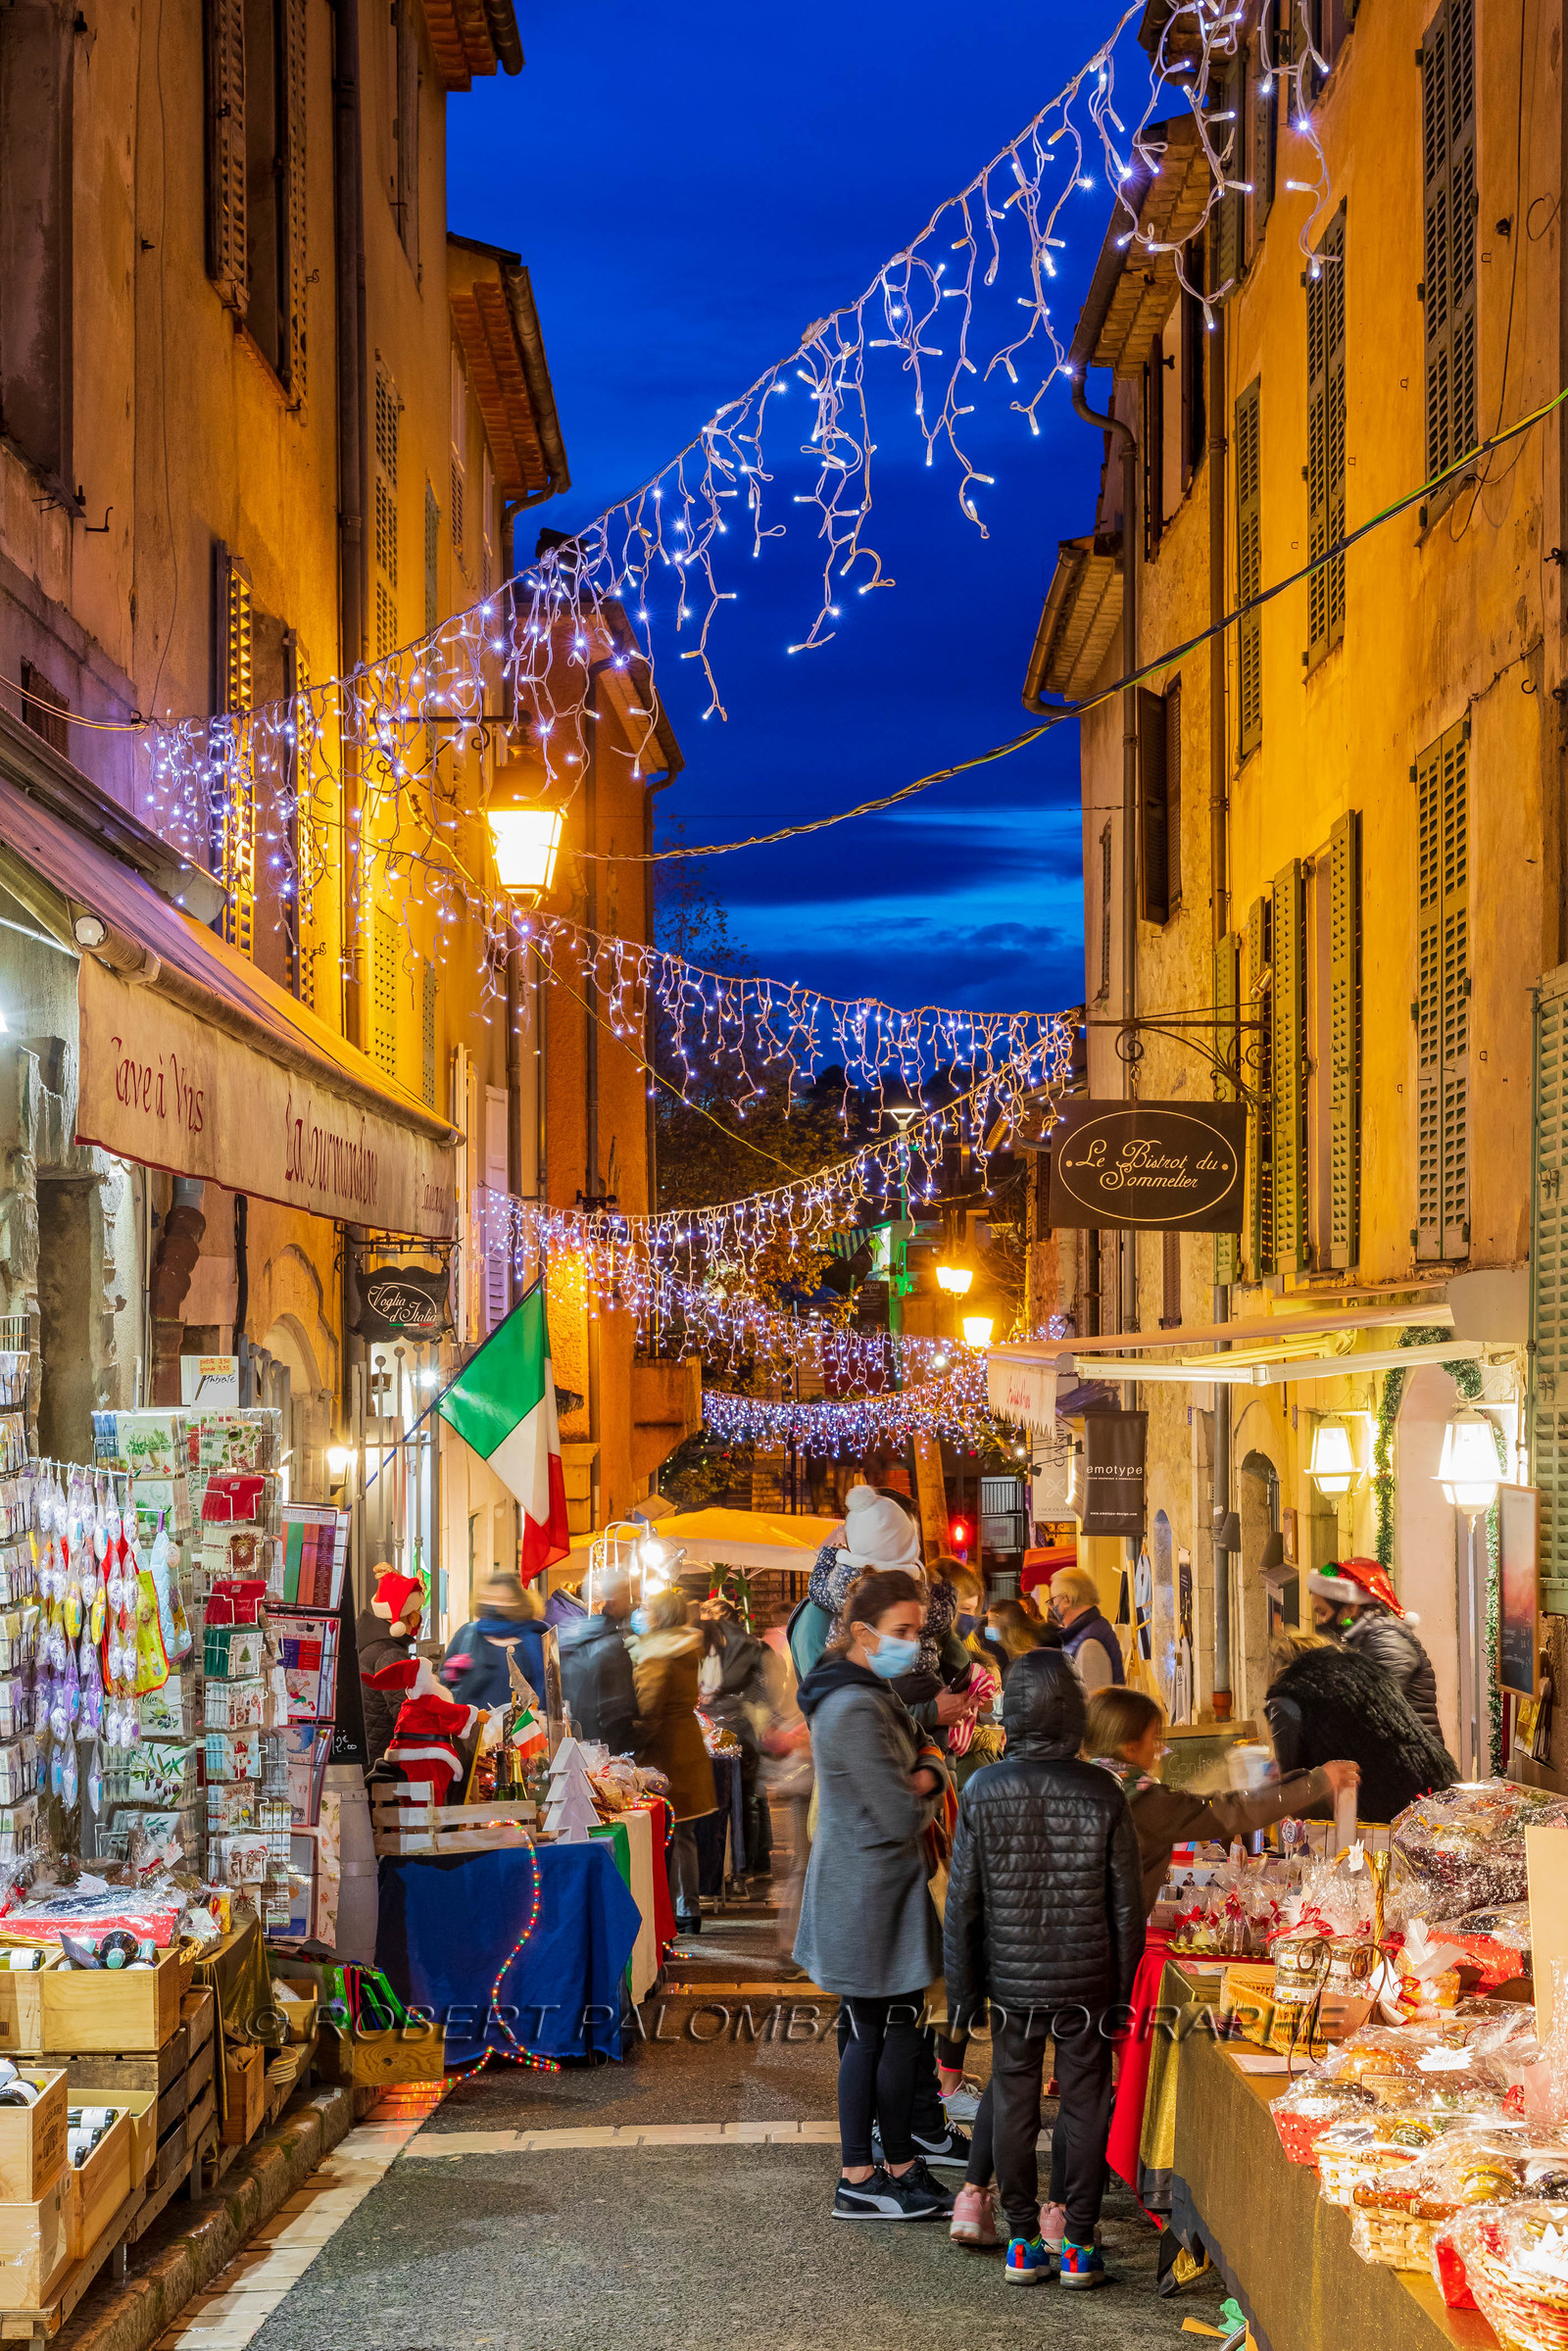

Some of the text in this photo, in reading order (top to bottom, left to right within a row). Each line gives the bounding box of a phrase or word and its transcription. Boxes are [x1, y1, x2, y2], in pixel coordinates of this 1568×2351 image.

[170, 1053, 204, 1132] Vns
[1075, 1139, 1218, 1170] Le Bistrot du
[1100, 1163, 1199, 1191] Sommelier
[368, 1285, 407, 1312] Voglia
[389, 1300, 437, 1323] d'Italia
[1086, 1465, 1143, 1476] emotype
